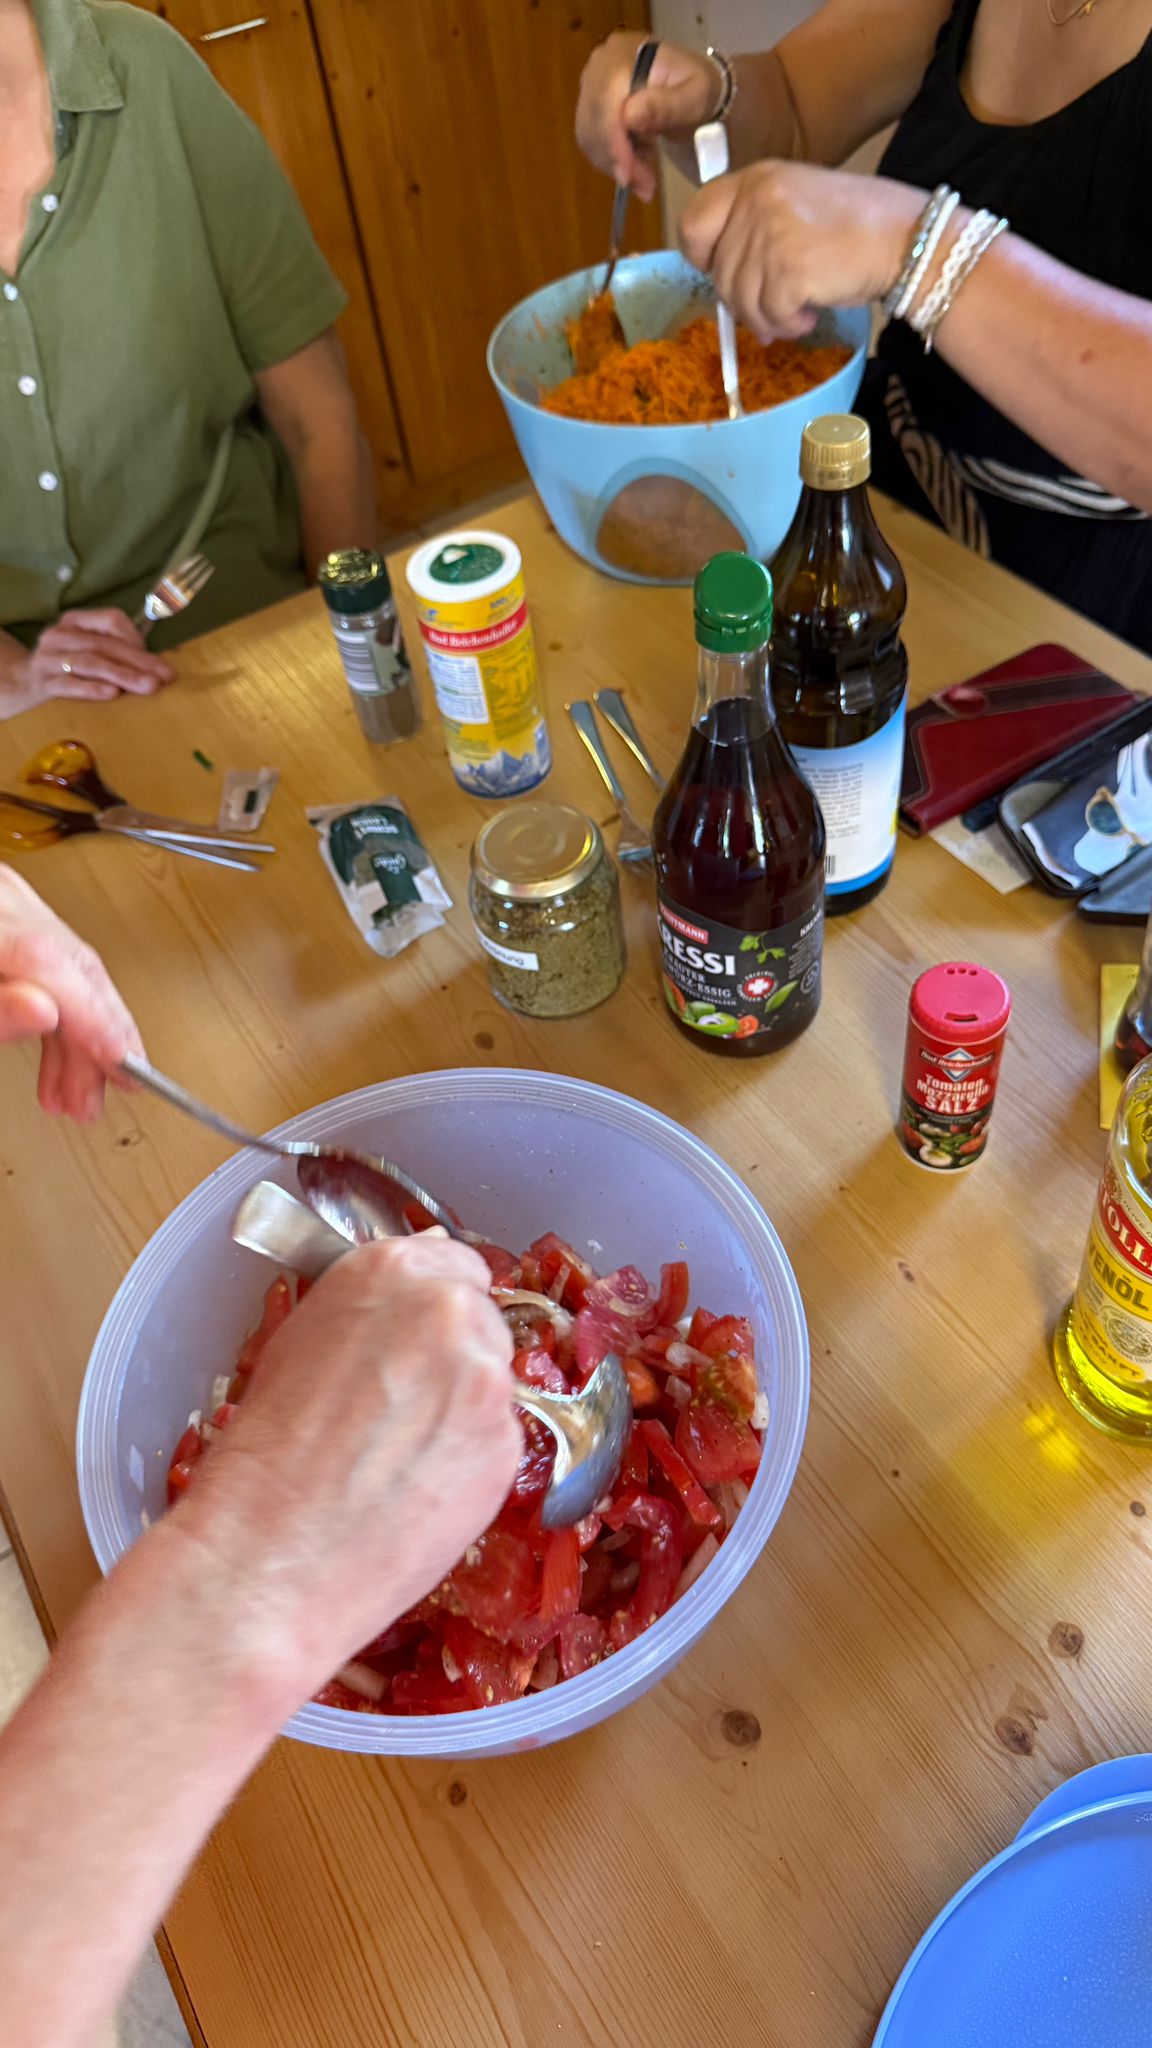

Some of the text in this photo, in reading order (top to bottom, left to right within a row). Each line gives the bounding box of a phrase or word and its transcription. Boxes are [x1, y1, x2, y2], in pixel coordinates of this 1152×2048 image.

[921, 1050, 937, 1064] Bad
[916, 1077, 990, 1102] Mozzarella
[924, 1073, 985, 1092] Tomaten
[924, 1095, 979, 1114] SALZ
[1090, 1245, 1149, 1312] ENÖL
